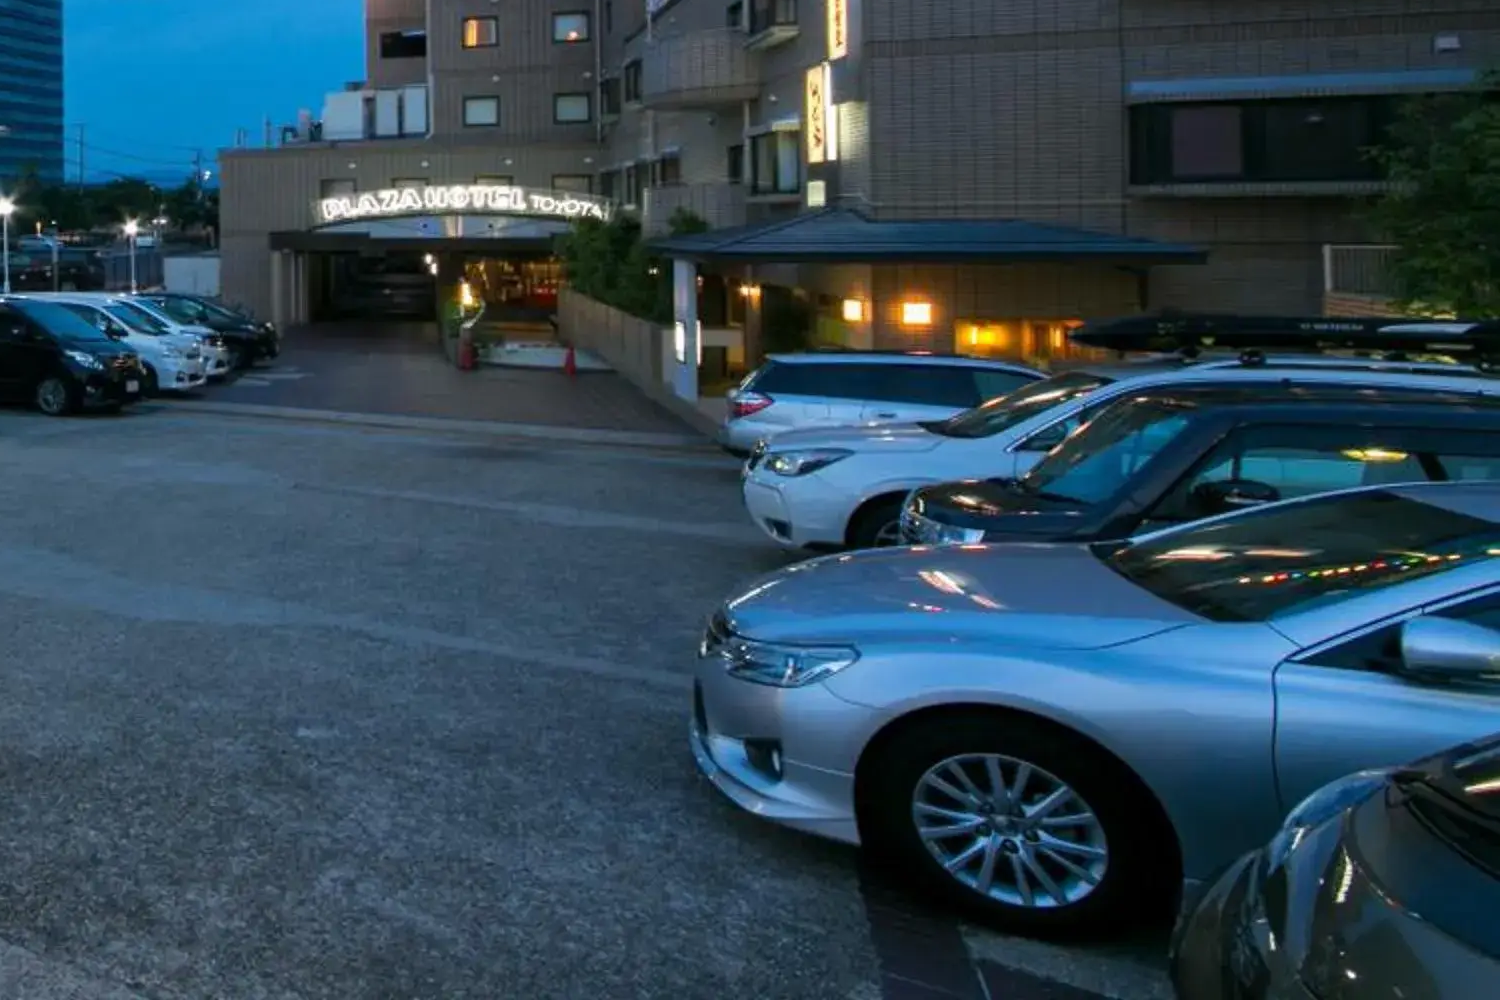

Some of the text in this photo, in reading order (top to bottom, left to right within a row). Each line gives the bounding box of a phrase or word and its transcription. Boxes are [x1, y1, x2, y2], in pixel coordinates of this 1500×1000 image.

[322, 185, 602, 220] PLAZA HOTEL TOYOTA
